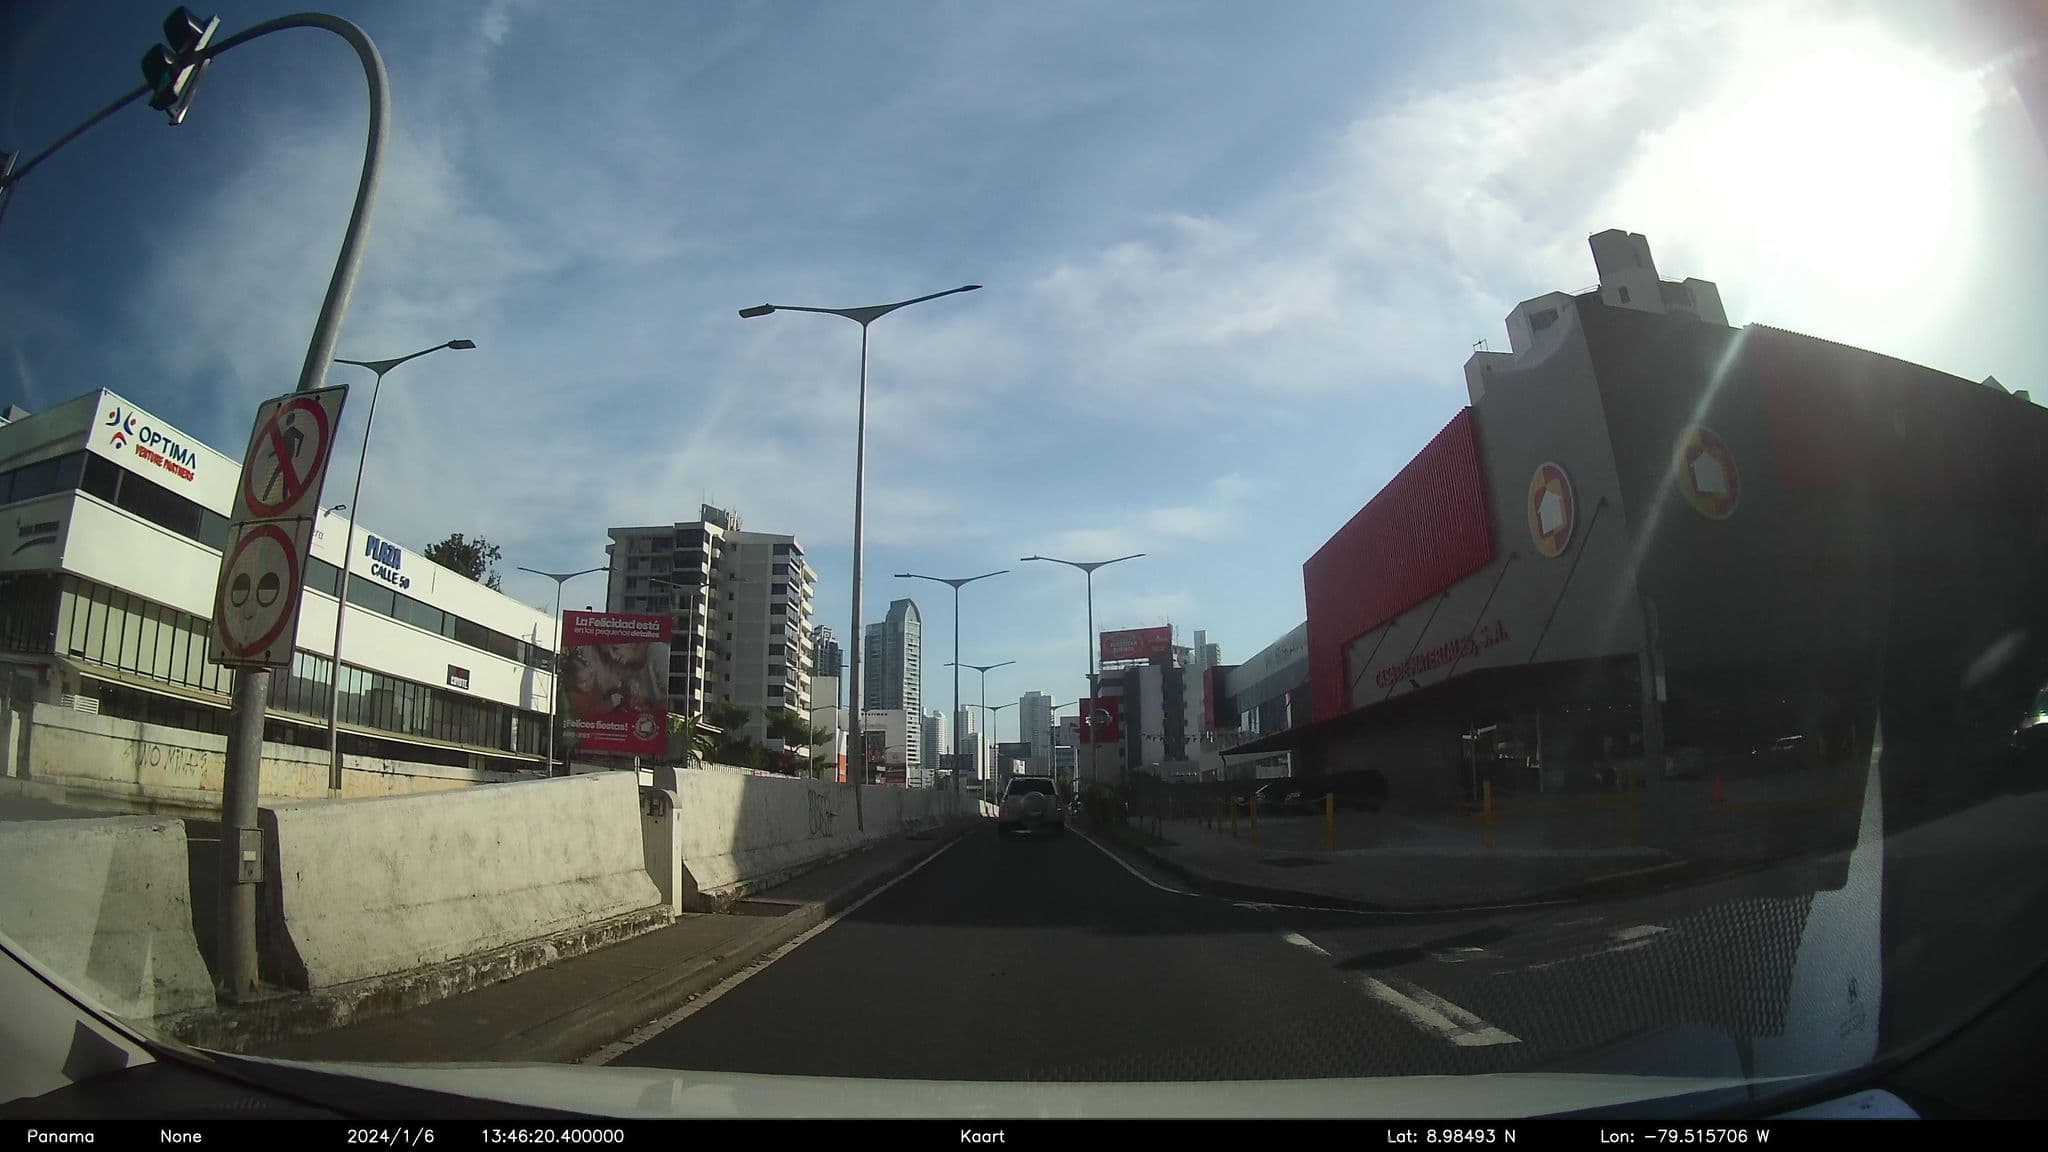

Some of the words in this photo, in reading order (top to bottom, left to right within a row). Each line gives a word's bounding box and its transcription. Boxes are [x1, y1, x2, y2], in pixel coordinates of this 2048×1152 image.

[139, 426, 196, 469] OPTIMA
[135, 444, 164, 467] VENTURE
[163, 459, 195, 482] PARTNERS
[365, 535, 402, 570] PLAZA
[371, 563, 399, 584] CALLE
[399, 576, 410, 589] 50
[575, 617, 588, 626] La
[588, 617, 636, 630] Felicidad
[636, 619, 660, 631] está
[562, 718, 595, 729] ¡Felices
[595, 720, 629, 731] fiestas!
